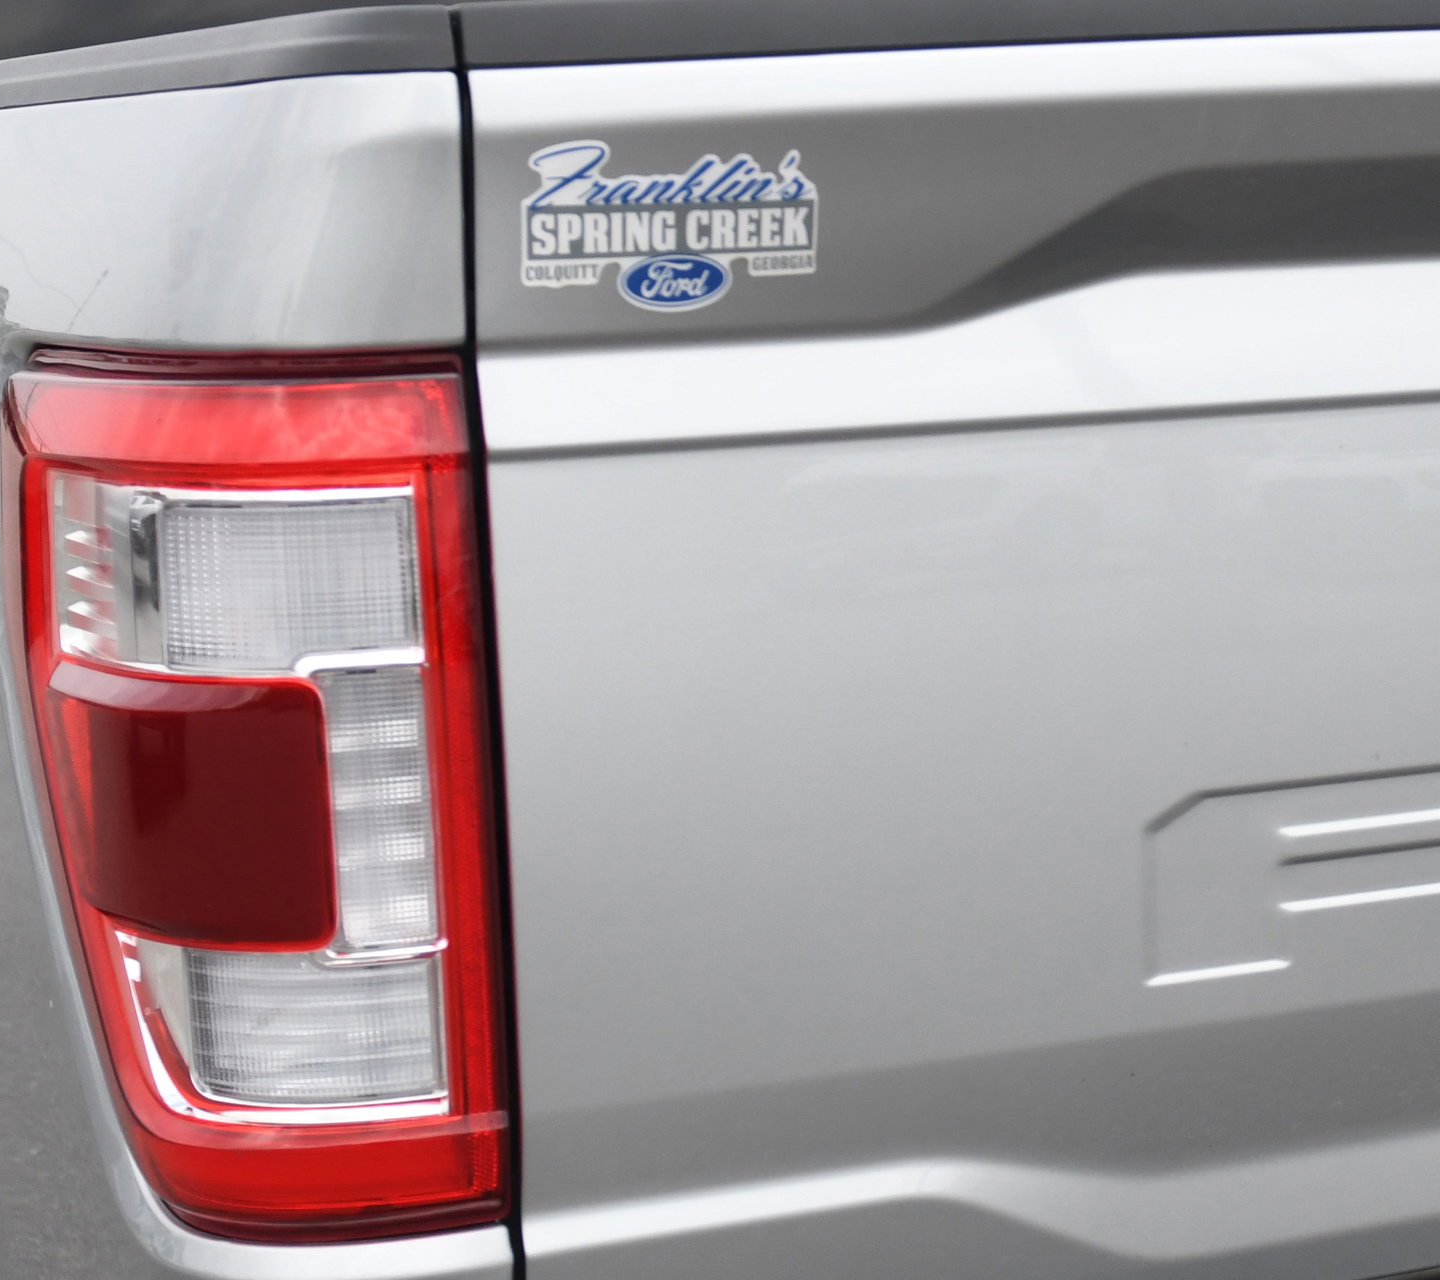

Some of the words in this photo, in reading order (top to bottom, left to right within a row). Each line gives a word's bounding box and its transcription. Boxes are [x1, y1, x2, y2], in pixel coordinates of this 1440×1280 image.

[529, 145, 812, 211] Franklin's
[530, 210, 677, 256] SPRING
[685, 206, 810, 251] CREEK
[525, 262, 599, 282] COLQUITT
[640, 261, 709, 298] Ford
[751, 253, 814, 272] GEORGIA
